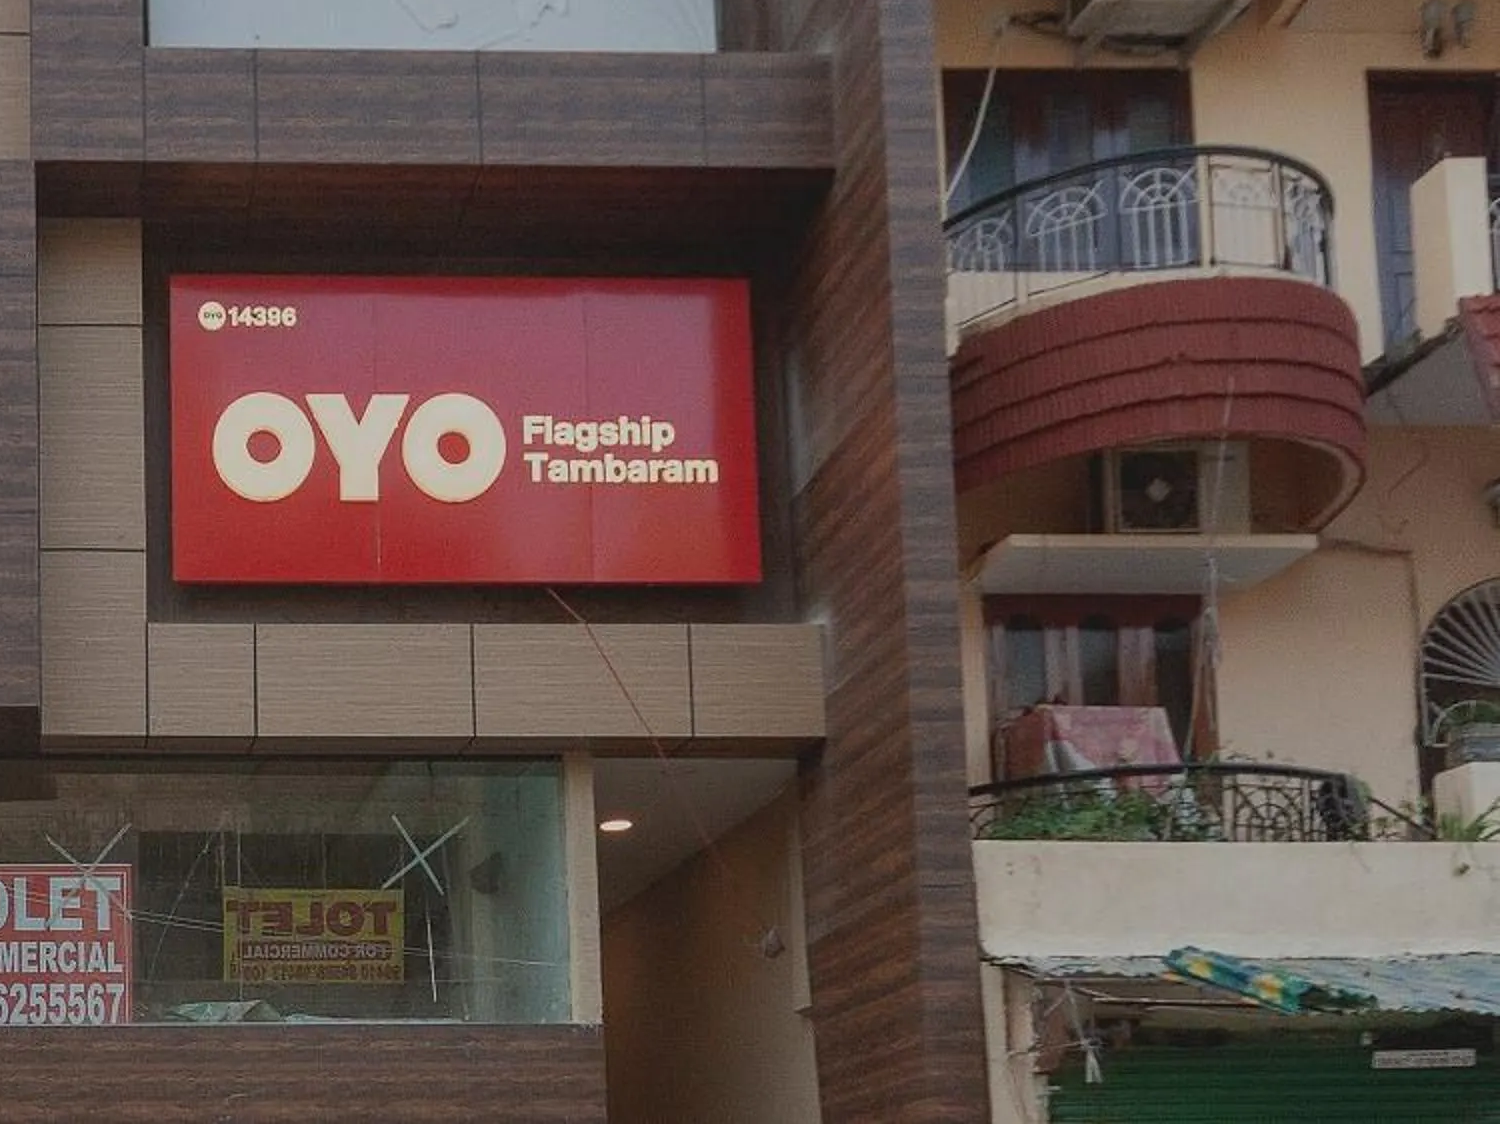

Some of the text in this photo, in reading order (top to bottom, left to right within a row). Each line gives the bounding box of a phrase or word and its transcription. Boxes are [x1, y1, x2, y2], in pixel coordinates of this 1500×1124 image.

[212, 392, 506, 502] OYO
[522, 416, 675, 451] Flagship
[524, 453, 719, 484] Tambaram
